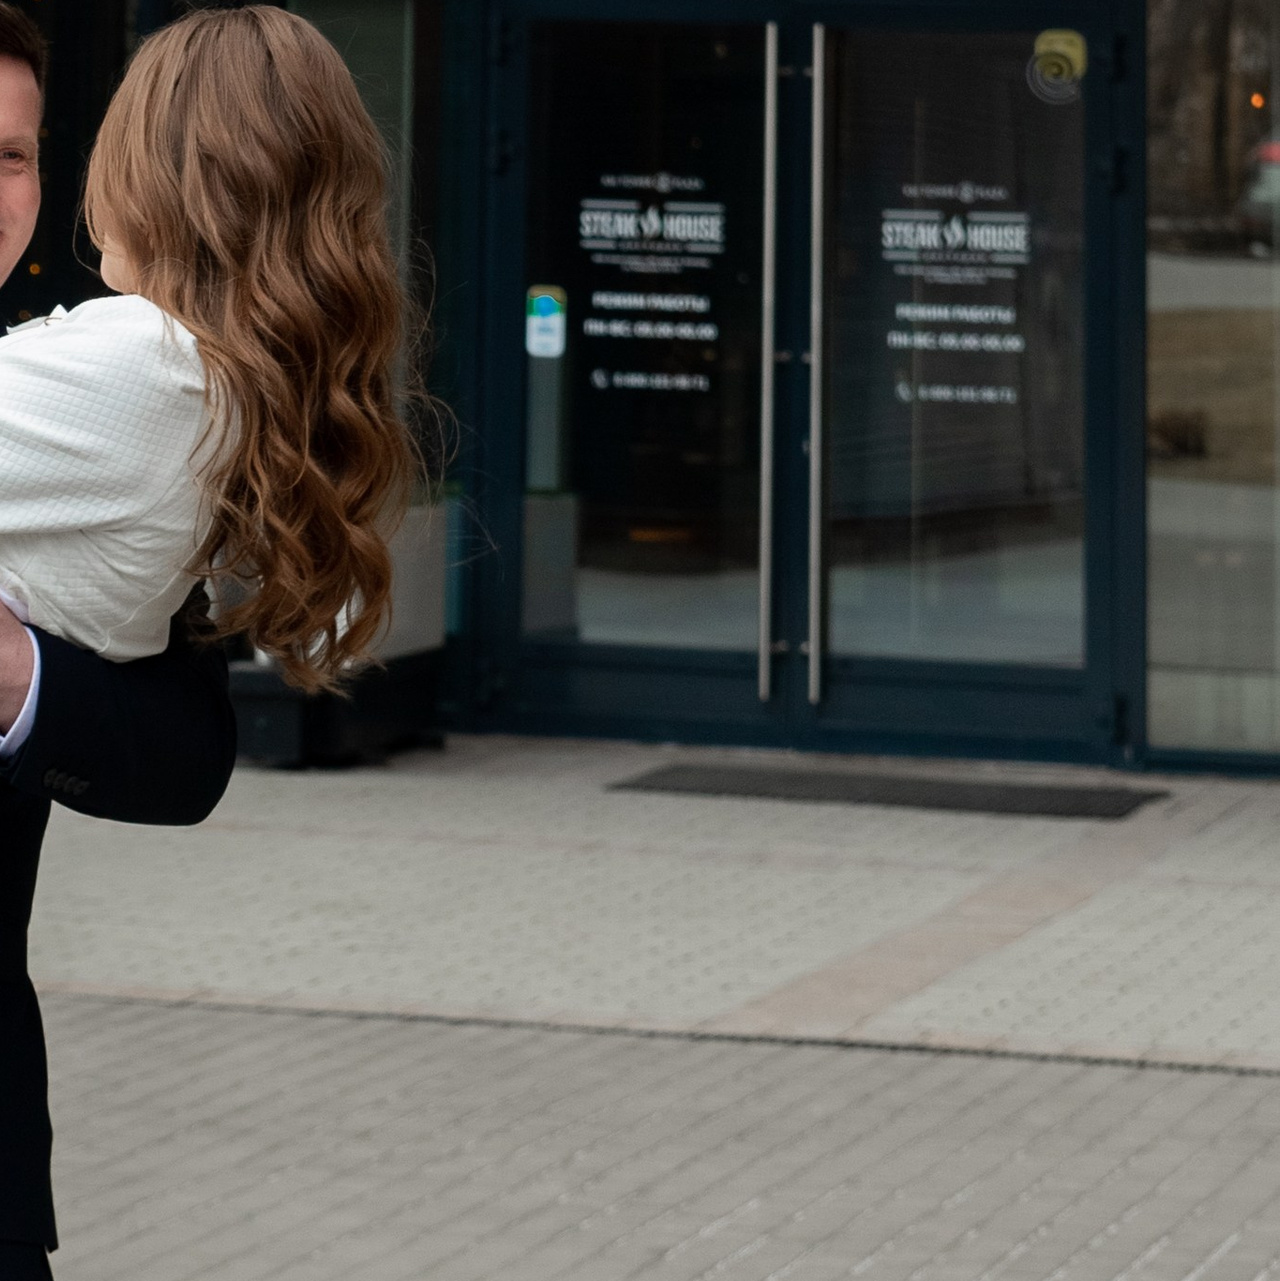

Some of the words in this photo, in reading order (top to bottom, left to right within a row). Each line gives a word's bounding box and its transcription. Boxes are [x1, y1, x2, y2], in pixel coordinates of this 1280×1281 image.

[579, 211, 639, 239] STEAK
[663, 214, 725, 242] HOUSE
[881, 221, 942, 249] STEAK
[967, 223, 1029, 252] HOUSE
